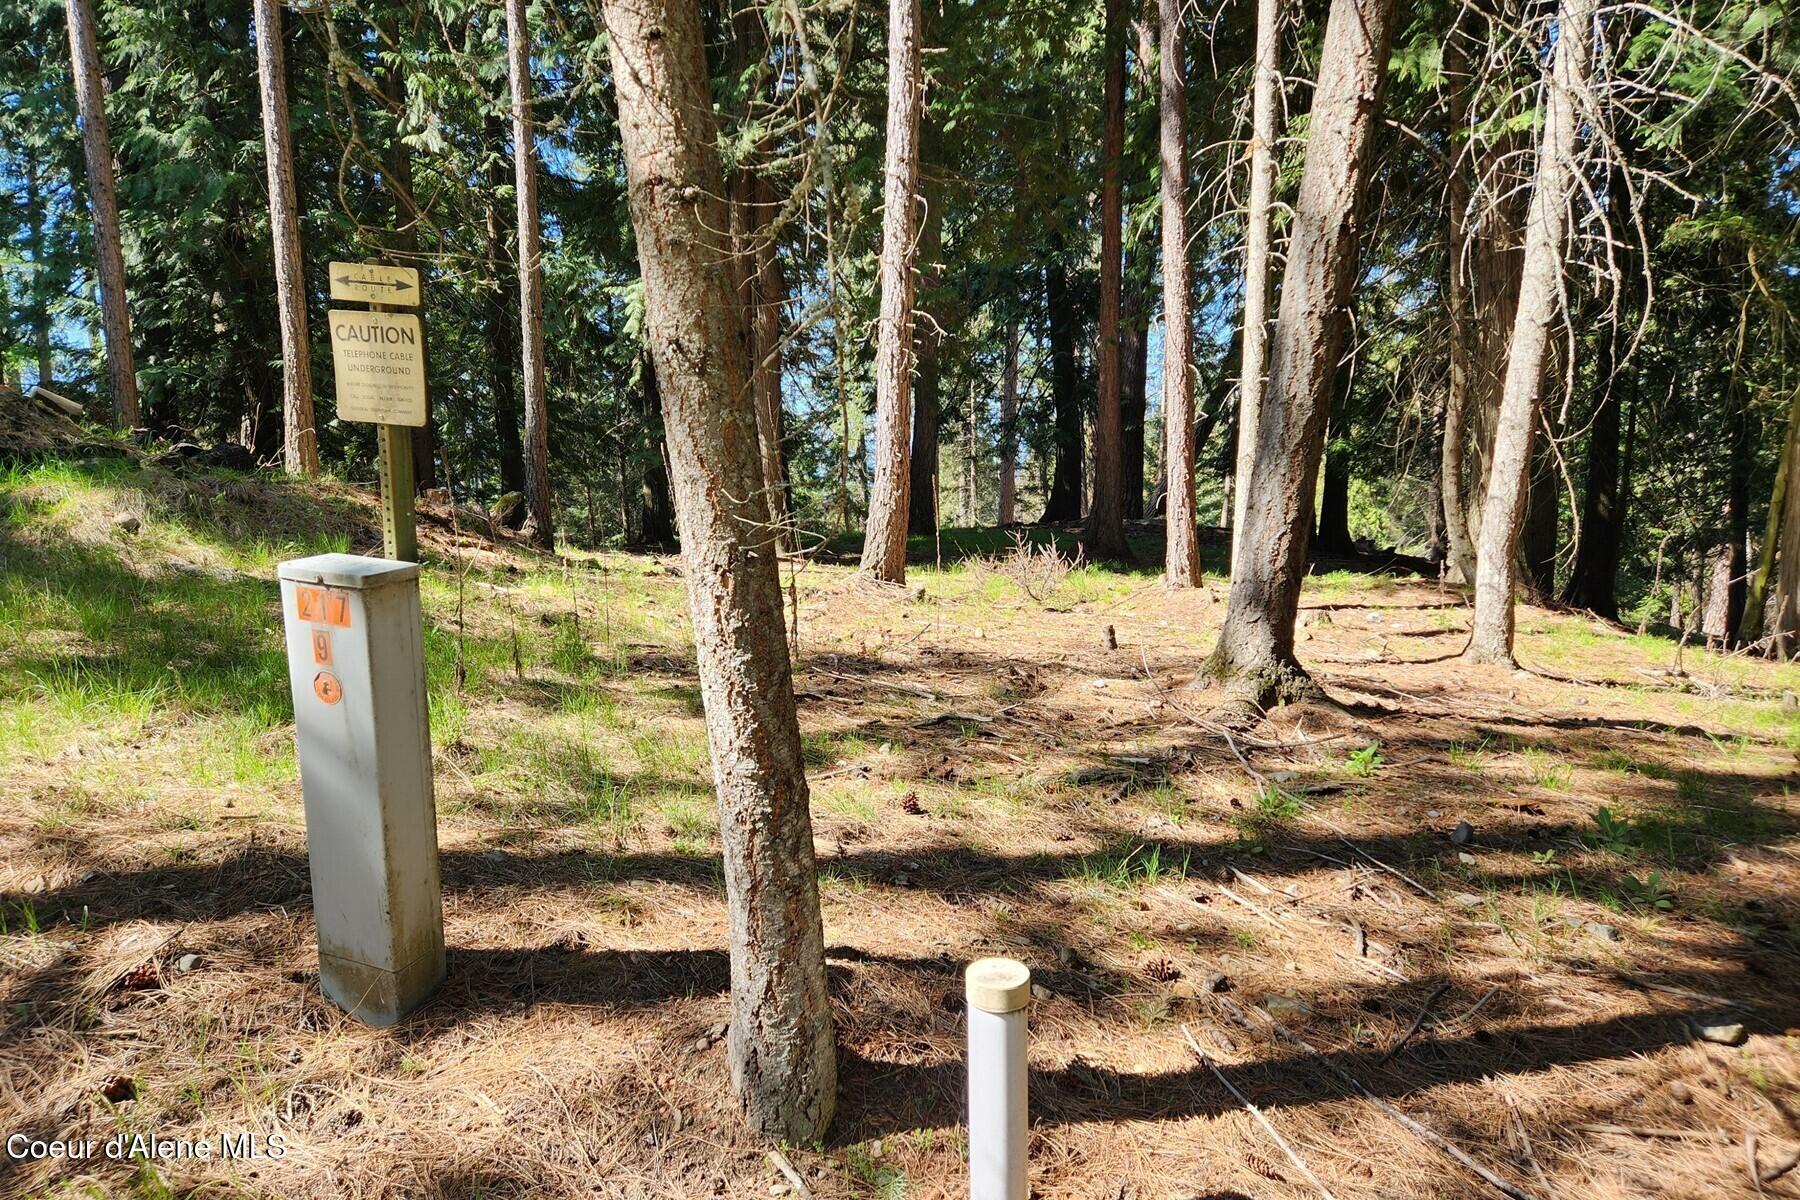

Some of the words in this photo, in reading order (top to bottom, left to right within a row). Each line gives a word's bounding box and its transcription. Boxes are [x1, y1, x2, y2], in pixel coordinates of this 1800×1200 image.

[335, 324, 415, 345] CAUTION
[343, 349, 387, 360] TELEPHONE
[389, 352, 414, 361] CABLE
[347, 363, 411, 375] UNDERGROUND
[317, 634, 328, 660] 9
